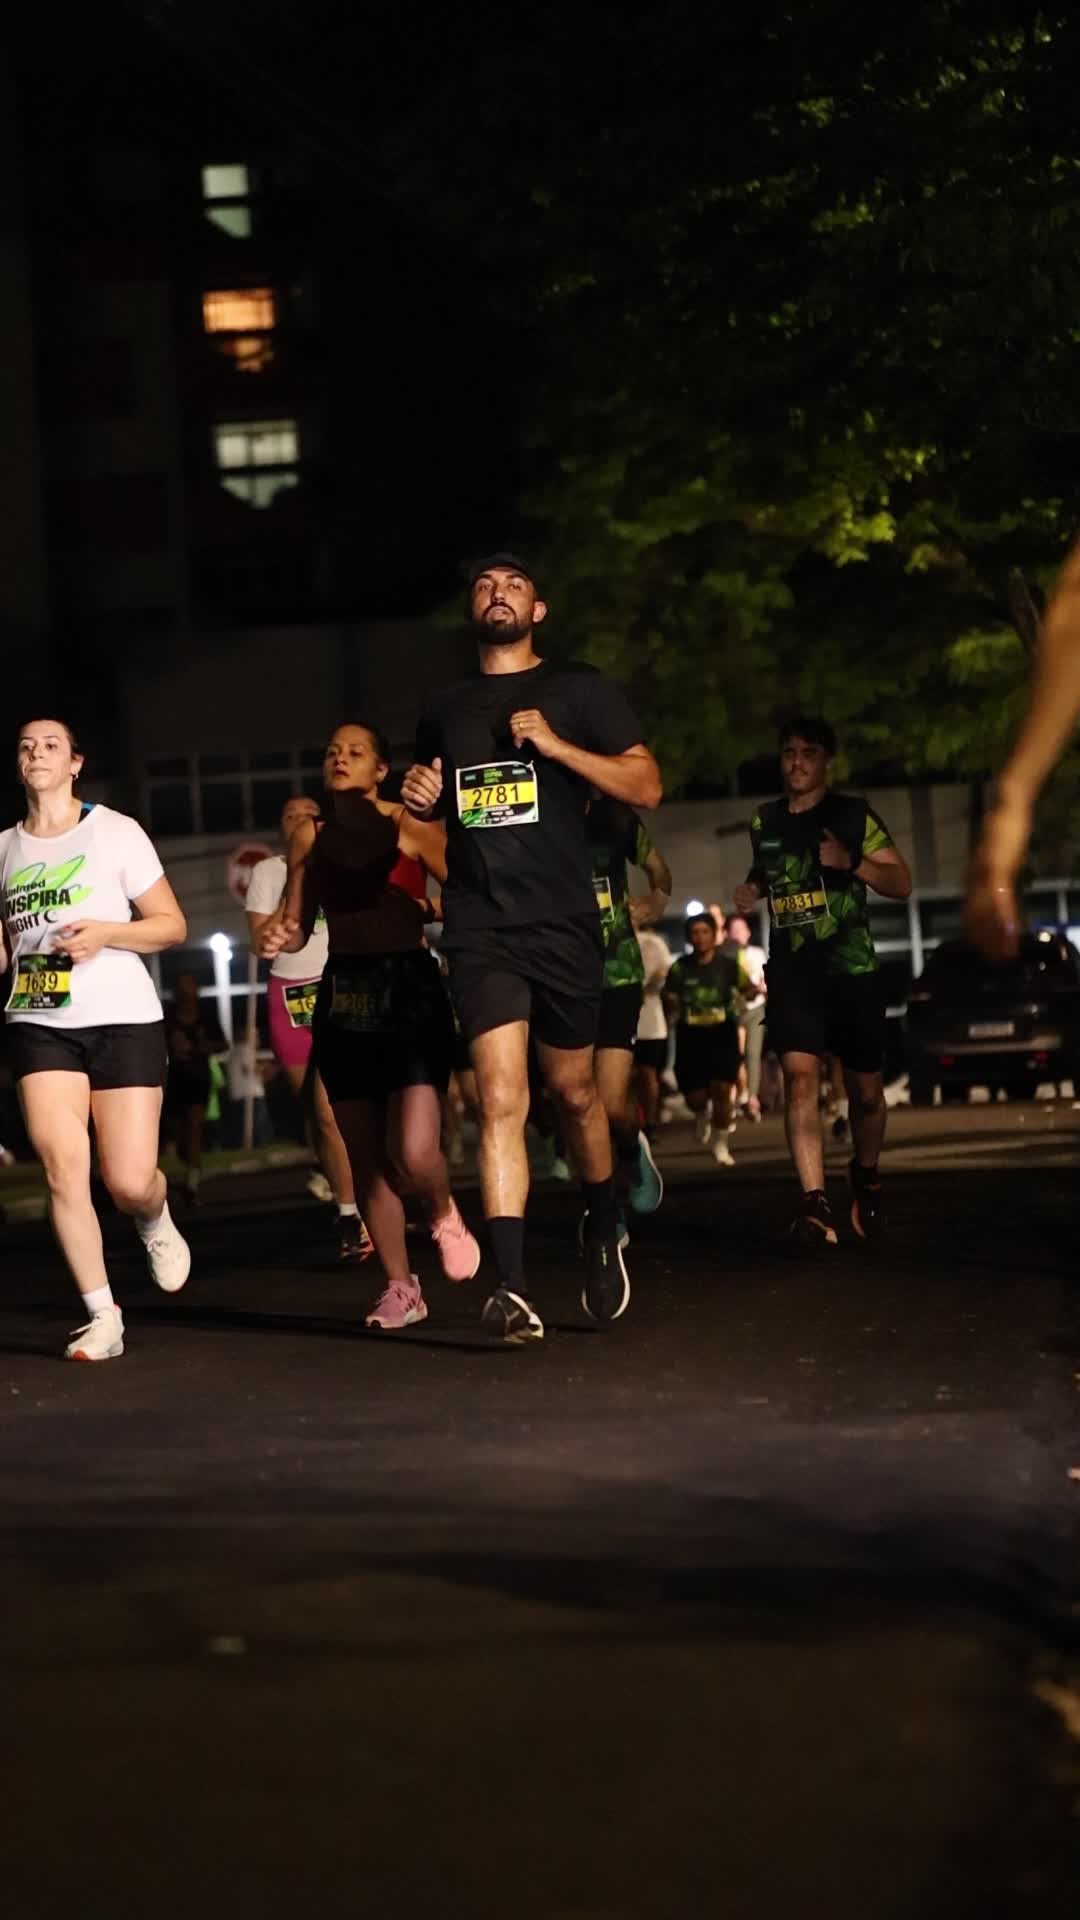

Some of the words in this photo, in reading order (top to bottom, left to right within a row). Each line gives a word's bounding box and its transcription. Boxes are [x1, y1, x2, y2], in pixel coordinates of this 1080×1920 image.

[472, 784, 519, 808] 2781
[780, 892, 815, 910] 2831
[25, 971, 58, 993] 1639
